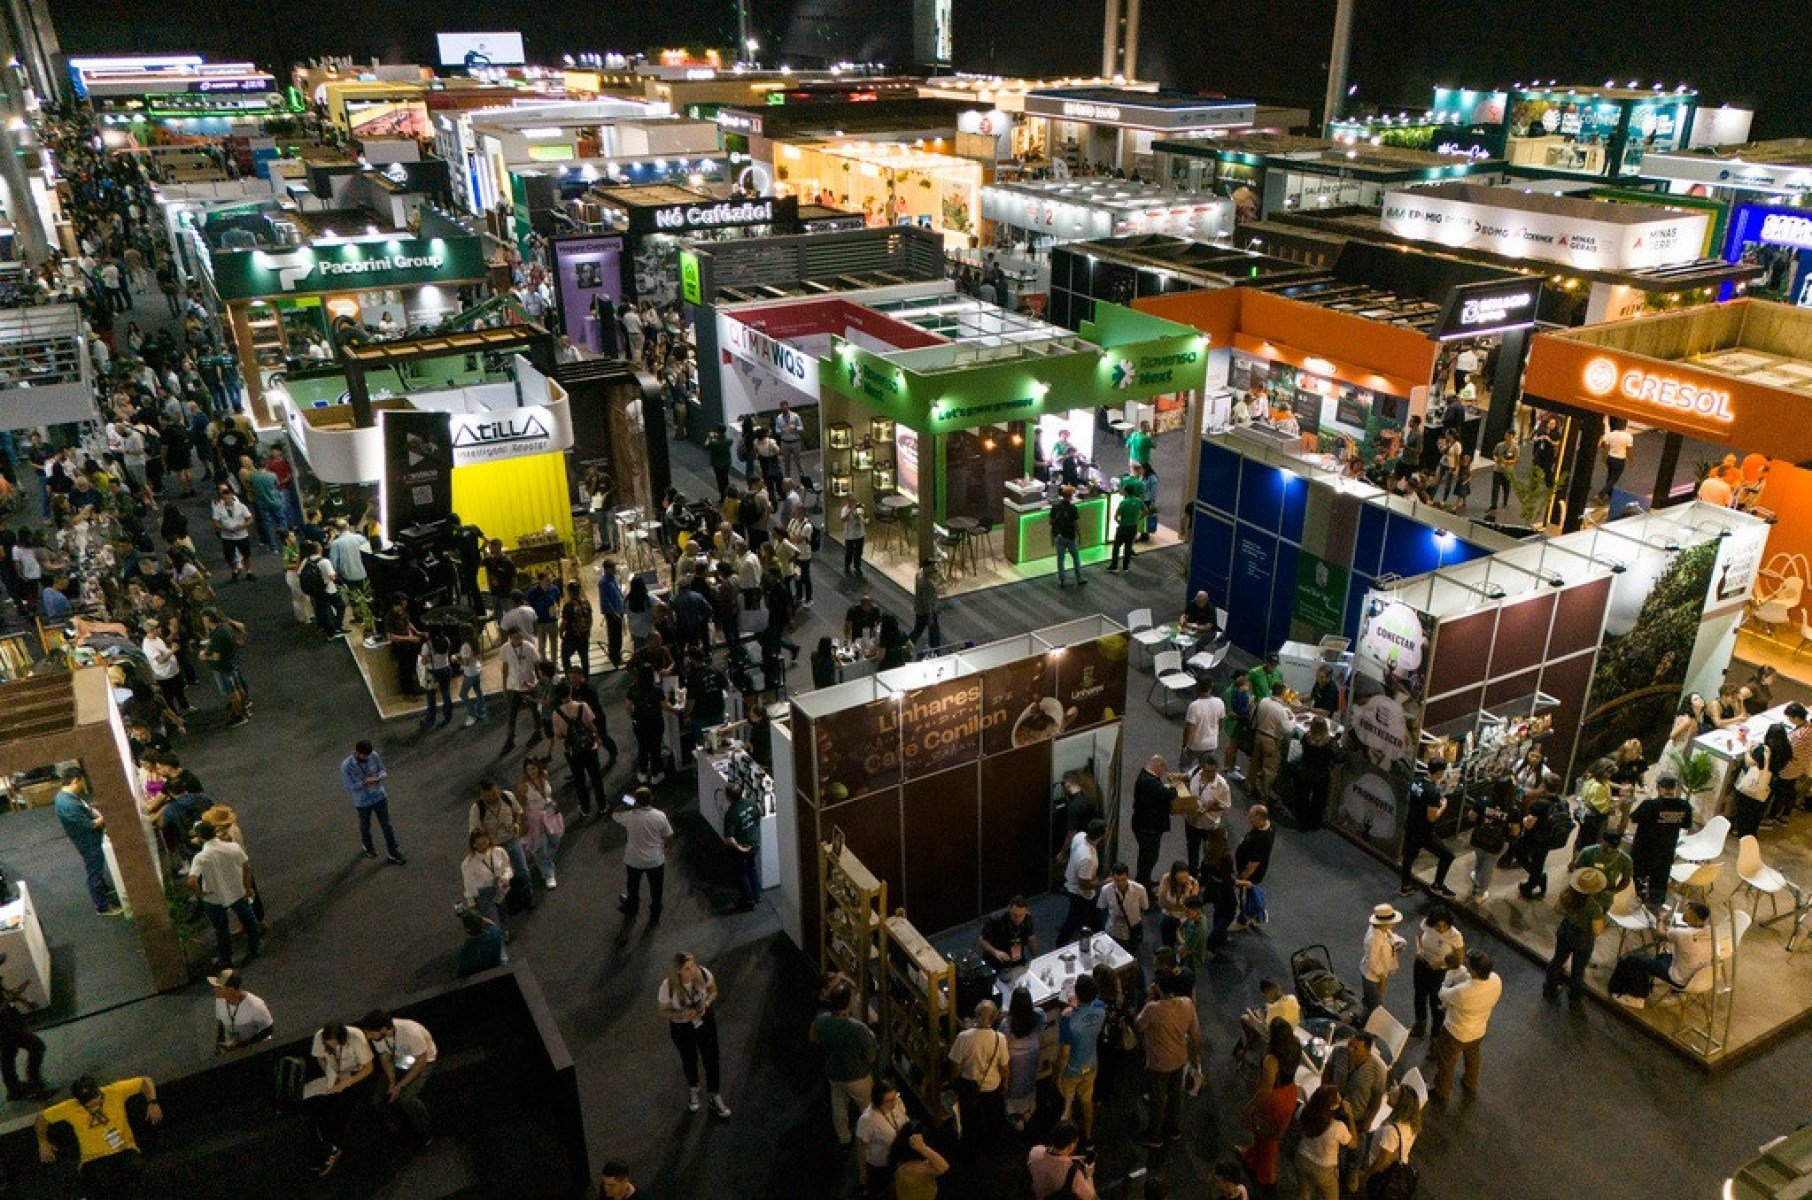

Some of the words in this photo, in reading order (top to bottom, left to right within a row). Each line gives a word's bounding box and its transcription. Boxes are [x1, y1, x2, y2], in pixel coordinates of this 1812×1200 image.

[318, 256, 391, 275] Pacorini
[394, 254, 444, 270] Group
[1140, 367, 1174, 385] Next
[1622, 371, 1733, 421] CRESOL
[878, 686, 981, 734] Linhares
[923, 708, 1007, 750] Conilon
